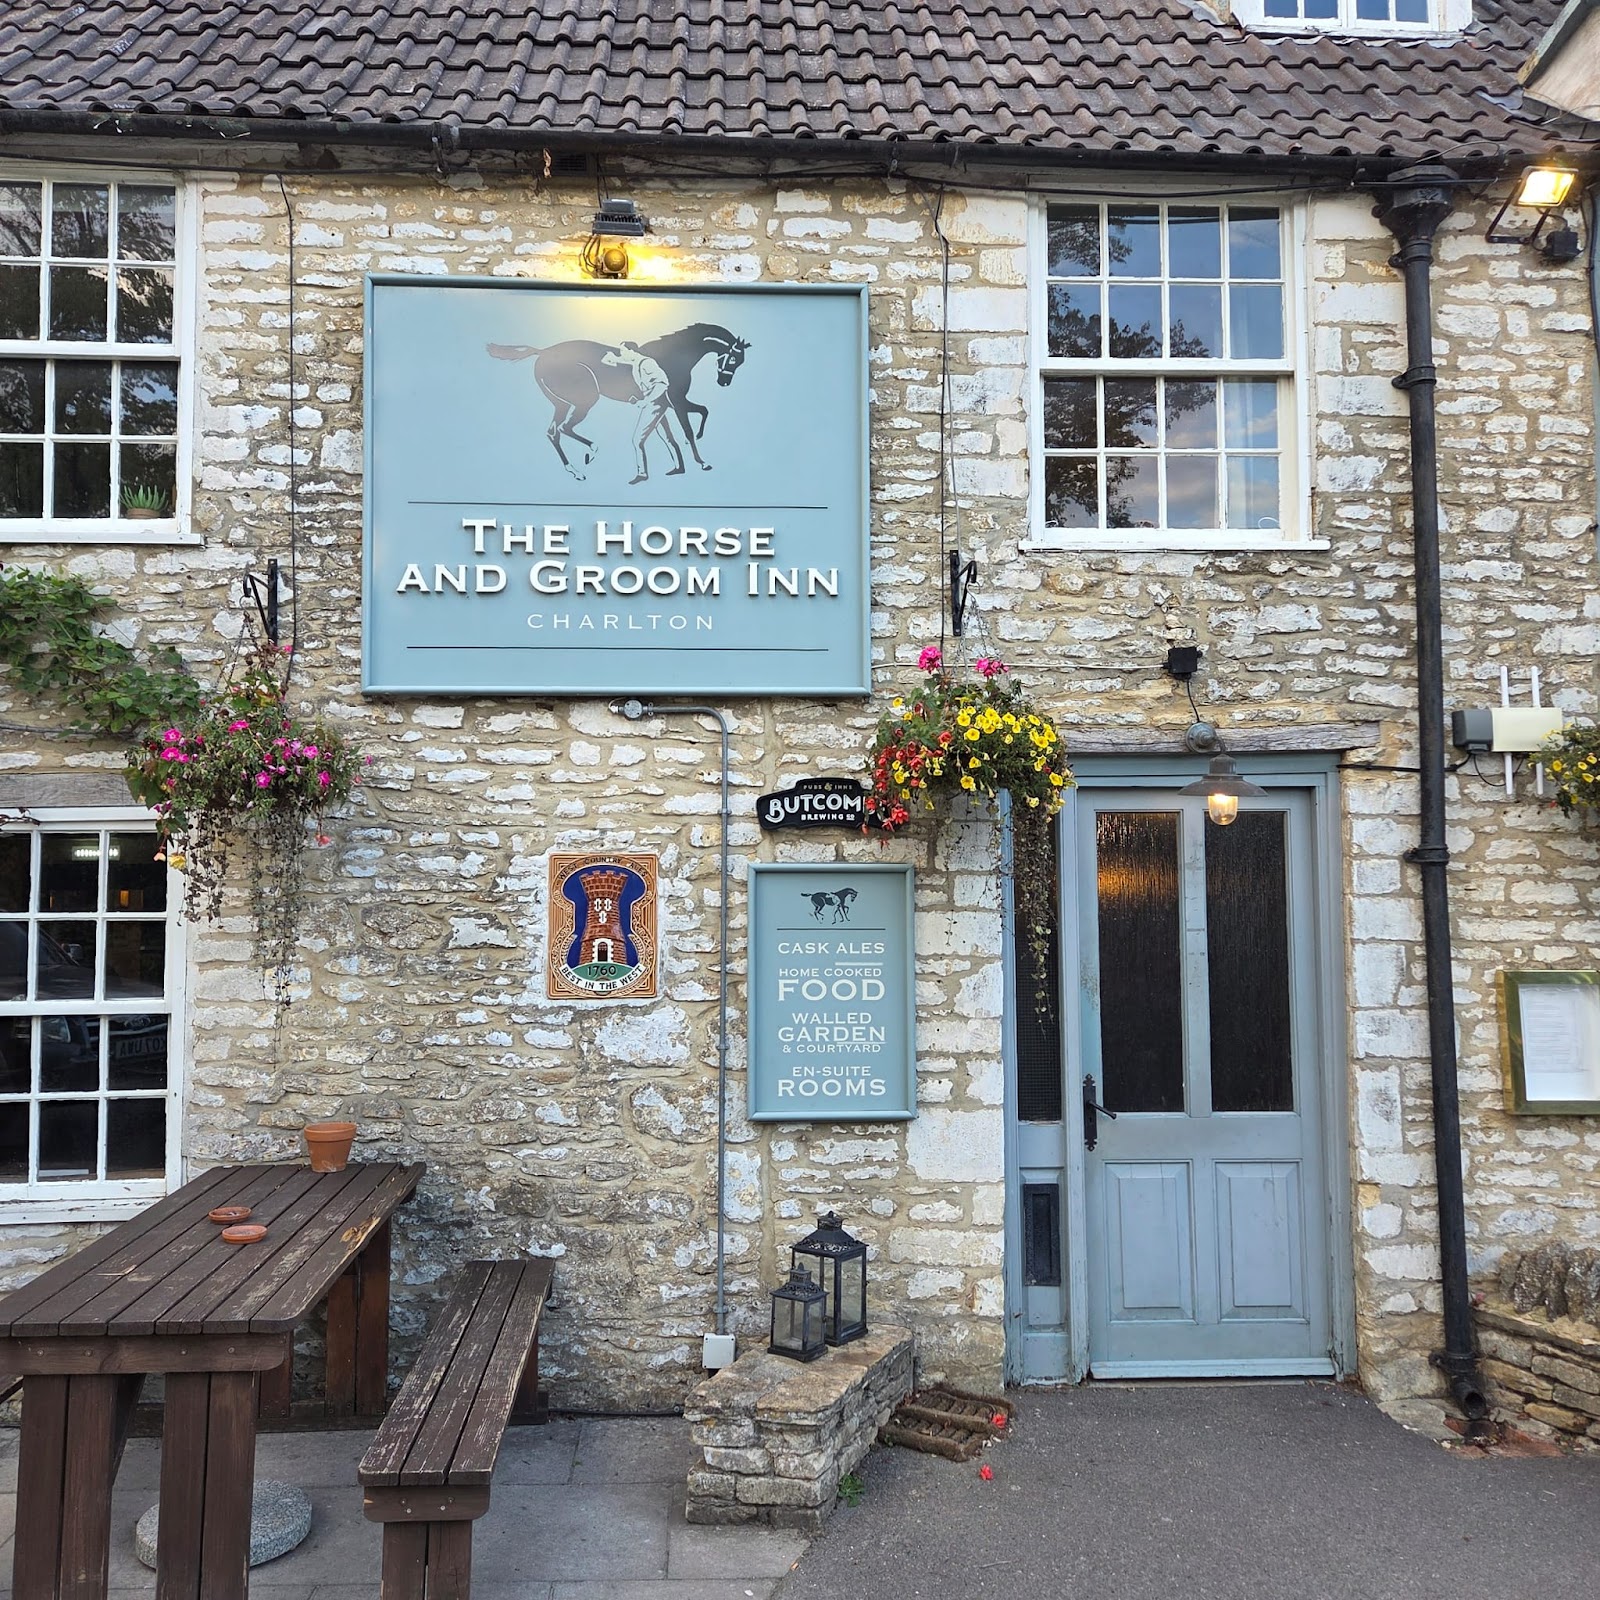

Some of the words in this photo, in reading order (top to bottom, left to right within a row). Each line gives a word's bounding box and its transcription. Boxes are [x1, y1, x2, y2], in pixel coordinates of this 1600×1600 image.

[461, 517, 571, 555] THE
[595, 520, 776, 558] HORSE
[395, 562, 508, 595] AND
[528, 559, 722, 598] GROOM
[745, 561, 840, 598] INN
[526, 612, 714, 631] CHARLTON
[765, 793, 884, 823] BUTCOM
[801, 813, 844, 821] BREWING
[558, 863, 578, 880] WEST
[629, 862, 648, 877] ALES
[777, 942, 830, 954] CASK
[836, 942, 885, 954] ALES
[561, 966, 582, 985] BEST
[585, 981, 595, 989] IN
[599, 981, 618, 989] THE
[620, 966, 643, 986] WEST
[587, 965, 617, 976] 1760
[779, 968, 820, 977] HOME
[823, 968, 882, 977] COOKED
[778, 979, 885, 1001] FOOD
[792, 1012, 872, 1024] WALLED
[778, 1026, 885, 1042] GARDEN
[782, 1044, 791, 1053] &
[796, 1044, 881, 1053] COURTYARD
[792, 1066, 872, 1077] EN-SUITE
[778, 1078, 887, 1097] ROOMS
